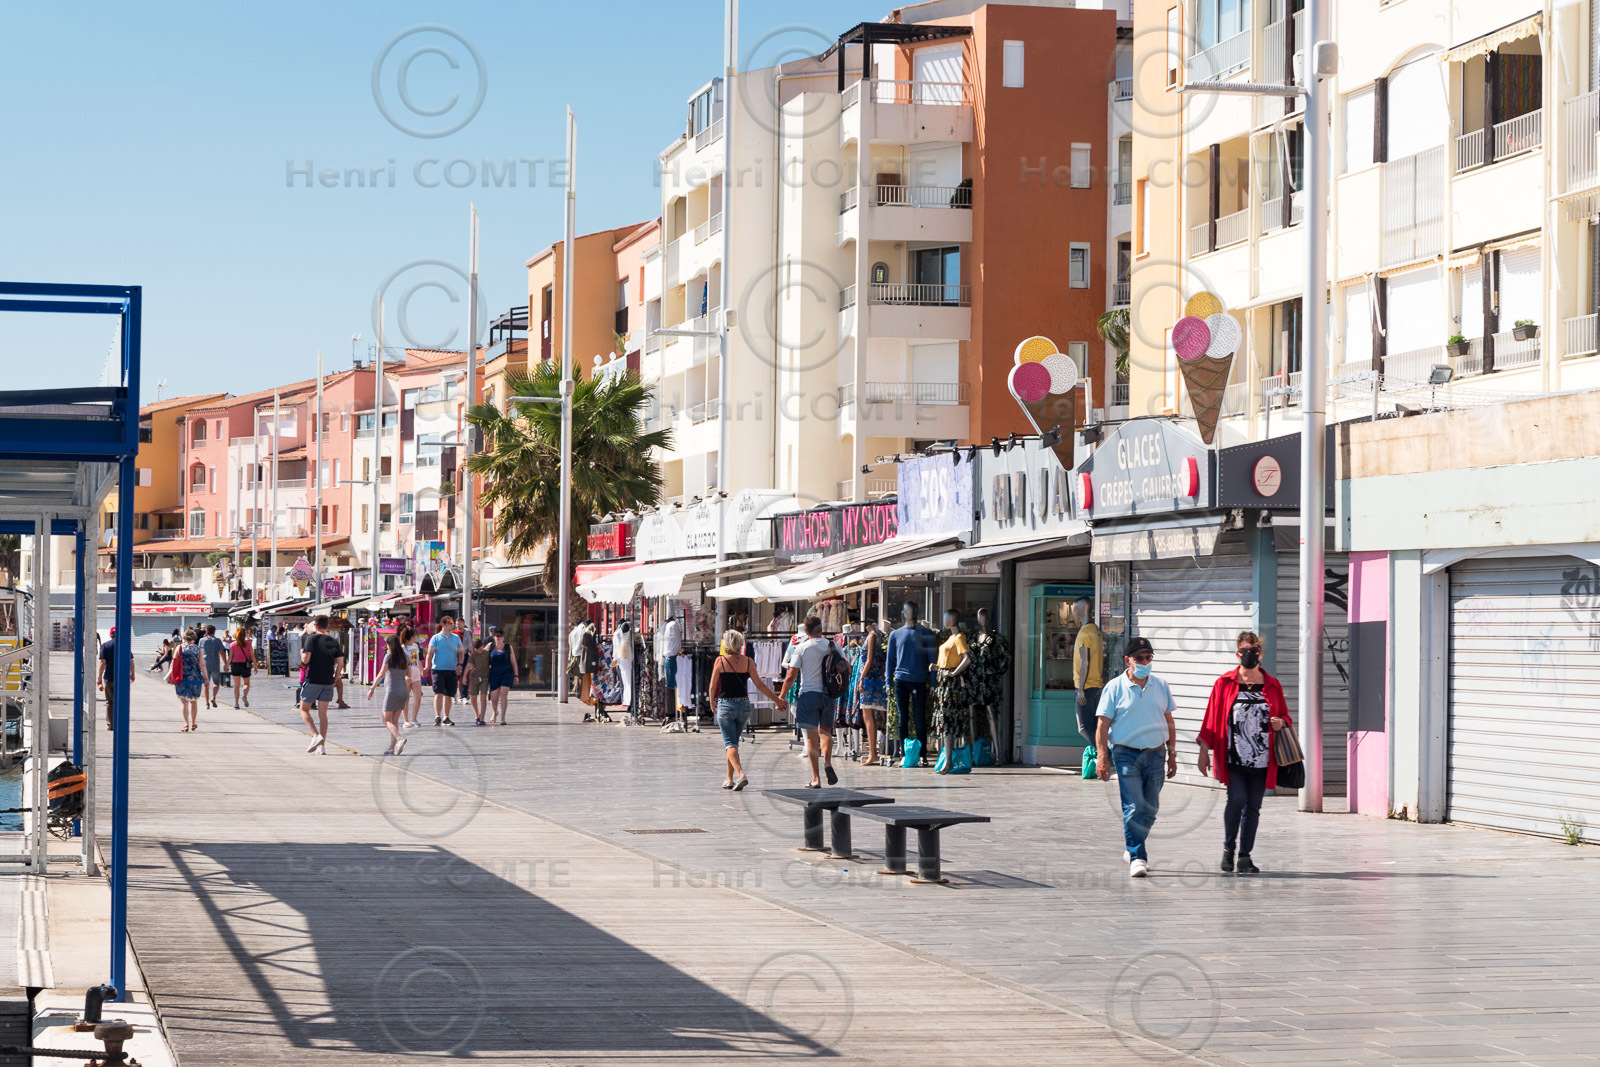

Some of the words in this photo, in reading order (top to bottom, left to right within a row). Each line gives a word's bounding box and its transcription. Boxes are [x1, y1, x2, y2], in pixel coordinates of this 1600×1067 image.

[1117, 432, 1160, 470] GLACES
[1100, 476, 1134, 507] CRÊPES
[1141, 472, 1181, 502] GAUFRES
[782, 515, 797, 551] MY
[799, 512, 831, 550] SHOES
[842, 506, 860, 546] MY
[861, 504, 898, 544] SHOES
